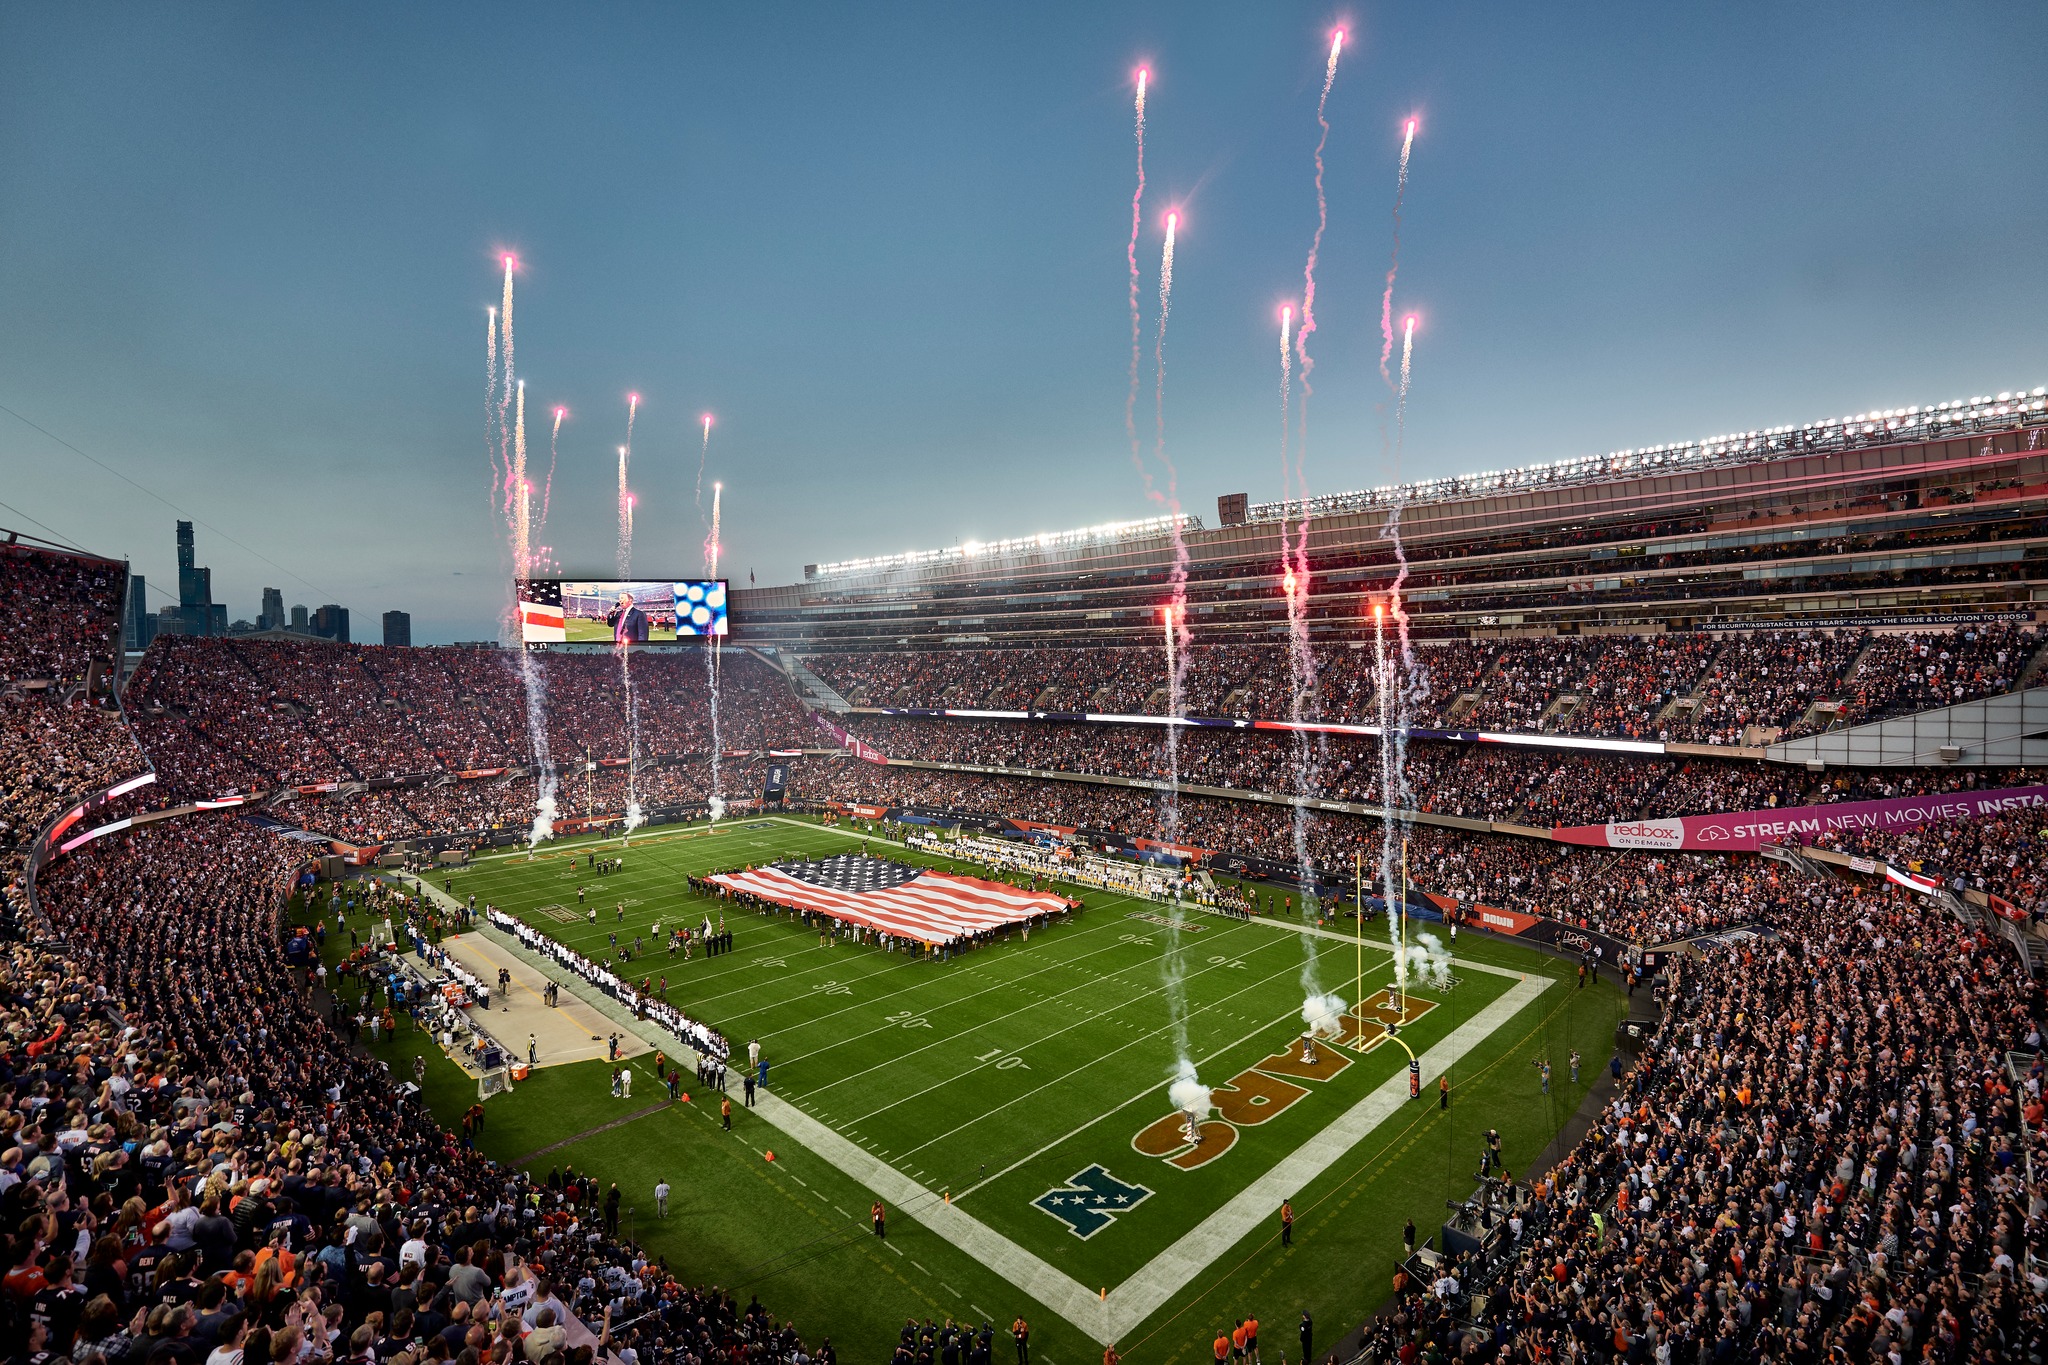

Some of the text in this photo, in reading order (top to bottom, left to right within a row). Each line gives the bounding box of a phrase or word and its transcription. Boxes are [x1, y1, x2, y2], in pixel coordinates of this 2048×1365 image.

[1717, 621, 1794, 630] SECURITY/ASSISTANCE
[1128, 779, 1151, 788] SOLDIER
[1320, 802, 1339, 810] proven
[1733, 818, 1820, 838] STREAM
[1826, 812, 1880, 830] NEW
[1884, 802, 1971, 825] MOVIES
[1634, 839, 1673, 848] DEMAND
[1482, 912, 1514, 929] DOWN
[812, 980, 849, 995] 30
[884, 1011, 928, 1028] 20
[974, 1048, 1023, 1070] 10
[1131, 988, 1441, 1172] BEARS
[126, 1099, 142, 1113] 52
[233, 1114, 245, 1126] 52
[1029, 1163, 1156, 1241] N
[272, 1219, 293, 1229] PAYTON
[139, 1256, 155, 1267] DENT
[609, 1273, 620, 1283] 34
[628, 1286, 637, 1294] 10
[162, 1294, 177, 1304] MACK
[504, 1289, 527, 1303] AMPTON
[34, 1302, 47, 1313] LONG
